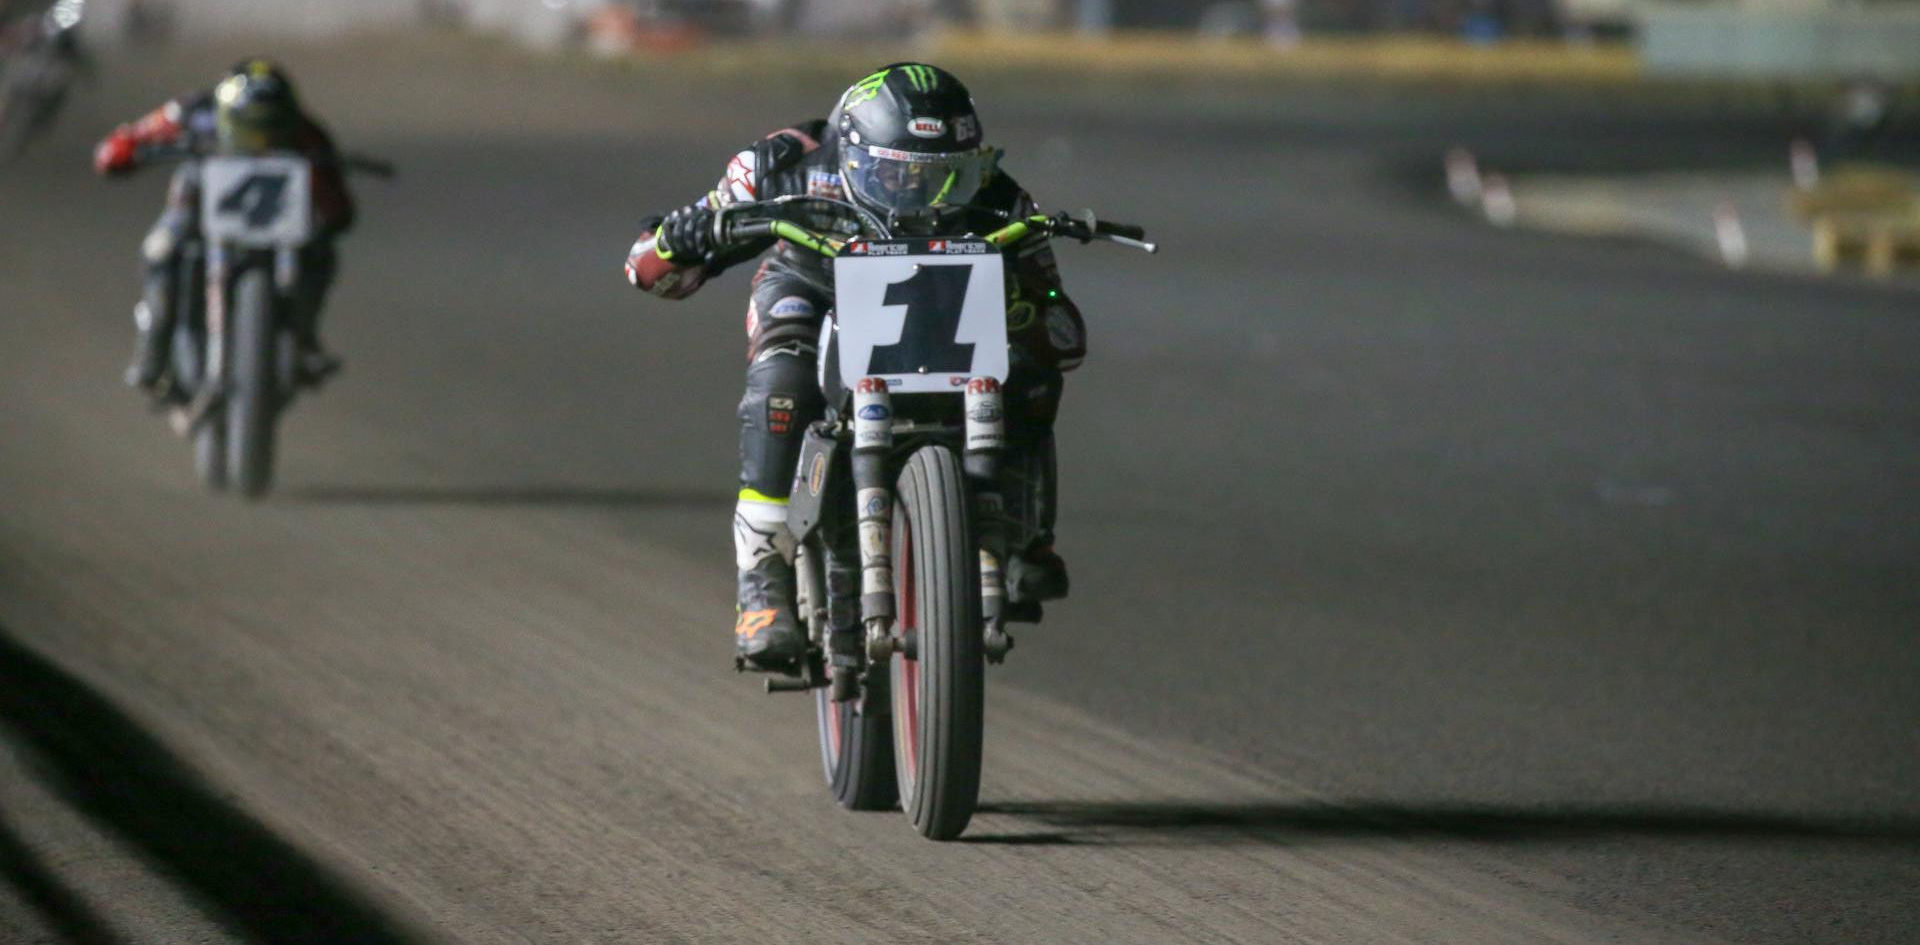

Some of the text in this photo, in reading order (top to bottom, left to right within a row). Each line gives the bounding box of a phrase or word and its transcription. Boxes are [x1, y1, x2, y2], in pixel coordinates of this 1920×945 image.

[915, 122, 941, 133] BELL
[216, 175, 289, 226] 4
[867, 264, 976, 375] 1
[967, 376, 1000, 395] RK
